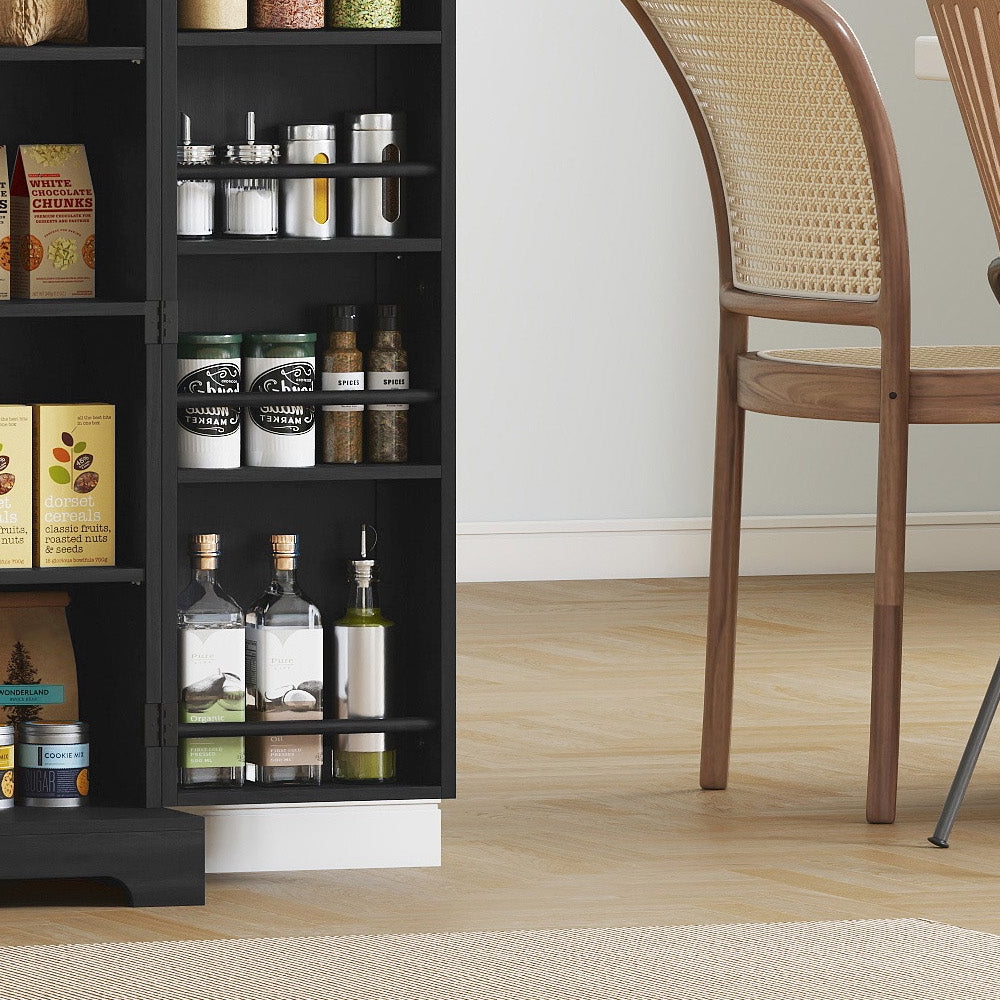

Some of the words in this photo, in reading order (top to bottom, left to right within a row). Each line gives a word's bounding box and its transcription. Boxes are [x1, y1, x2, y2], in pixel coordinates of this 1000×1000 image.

[29, 180, 72, 188] WHITE
[32, 189, 93, 197] CHOCOLATE
[33, 198, 93, 209] CHUNKS
[44, 496, 95, 509] dorset
[44, 510, 102, 523] cereals
[45, 525, 79, 534] classic
[81, 524, 112, 534] fruits,
[1, 537, 25, 545] nuts
[45, 534, 83, 544] roasted
[85, 535, 108, 543] nuts
[45, 546, 54, 554] &
[55, 545, 84, 554] seeds
[190, 715, 225, 723] Organic
[26, 770, 56, 793] SUGAR
